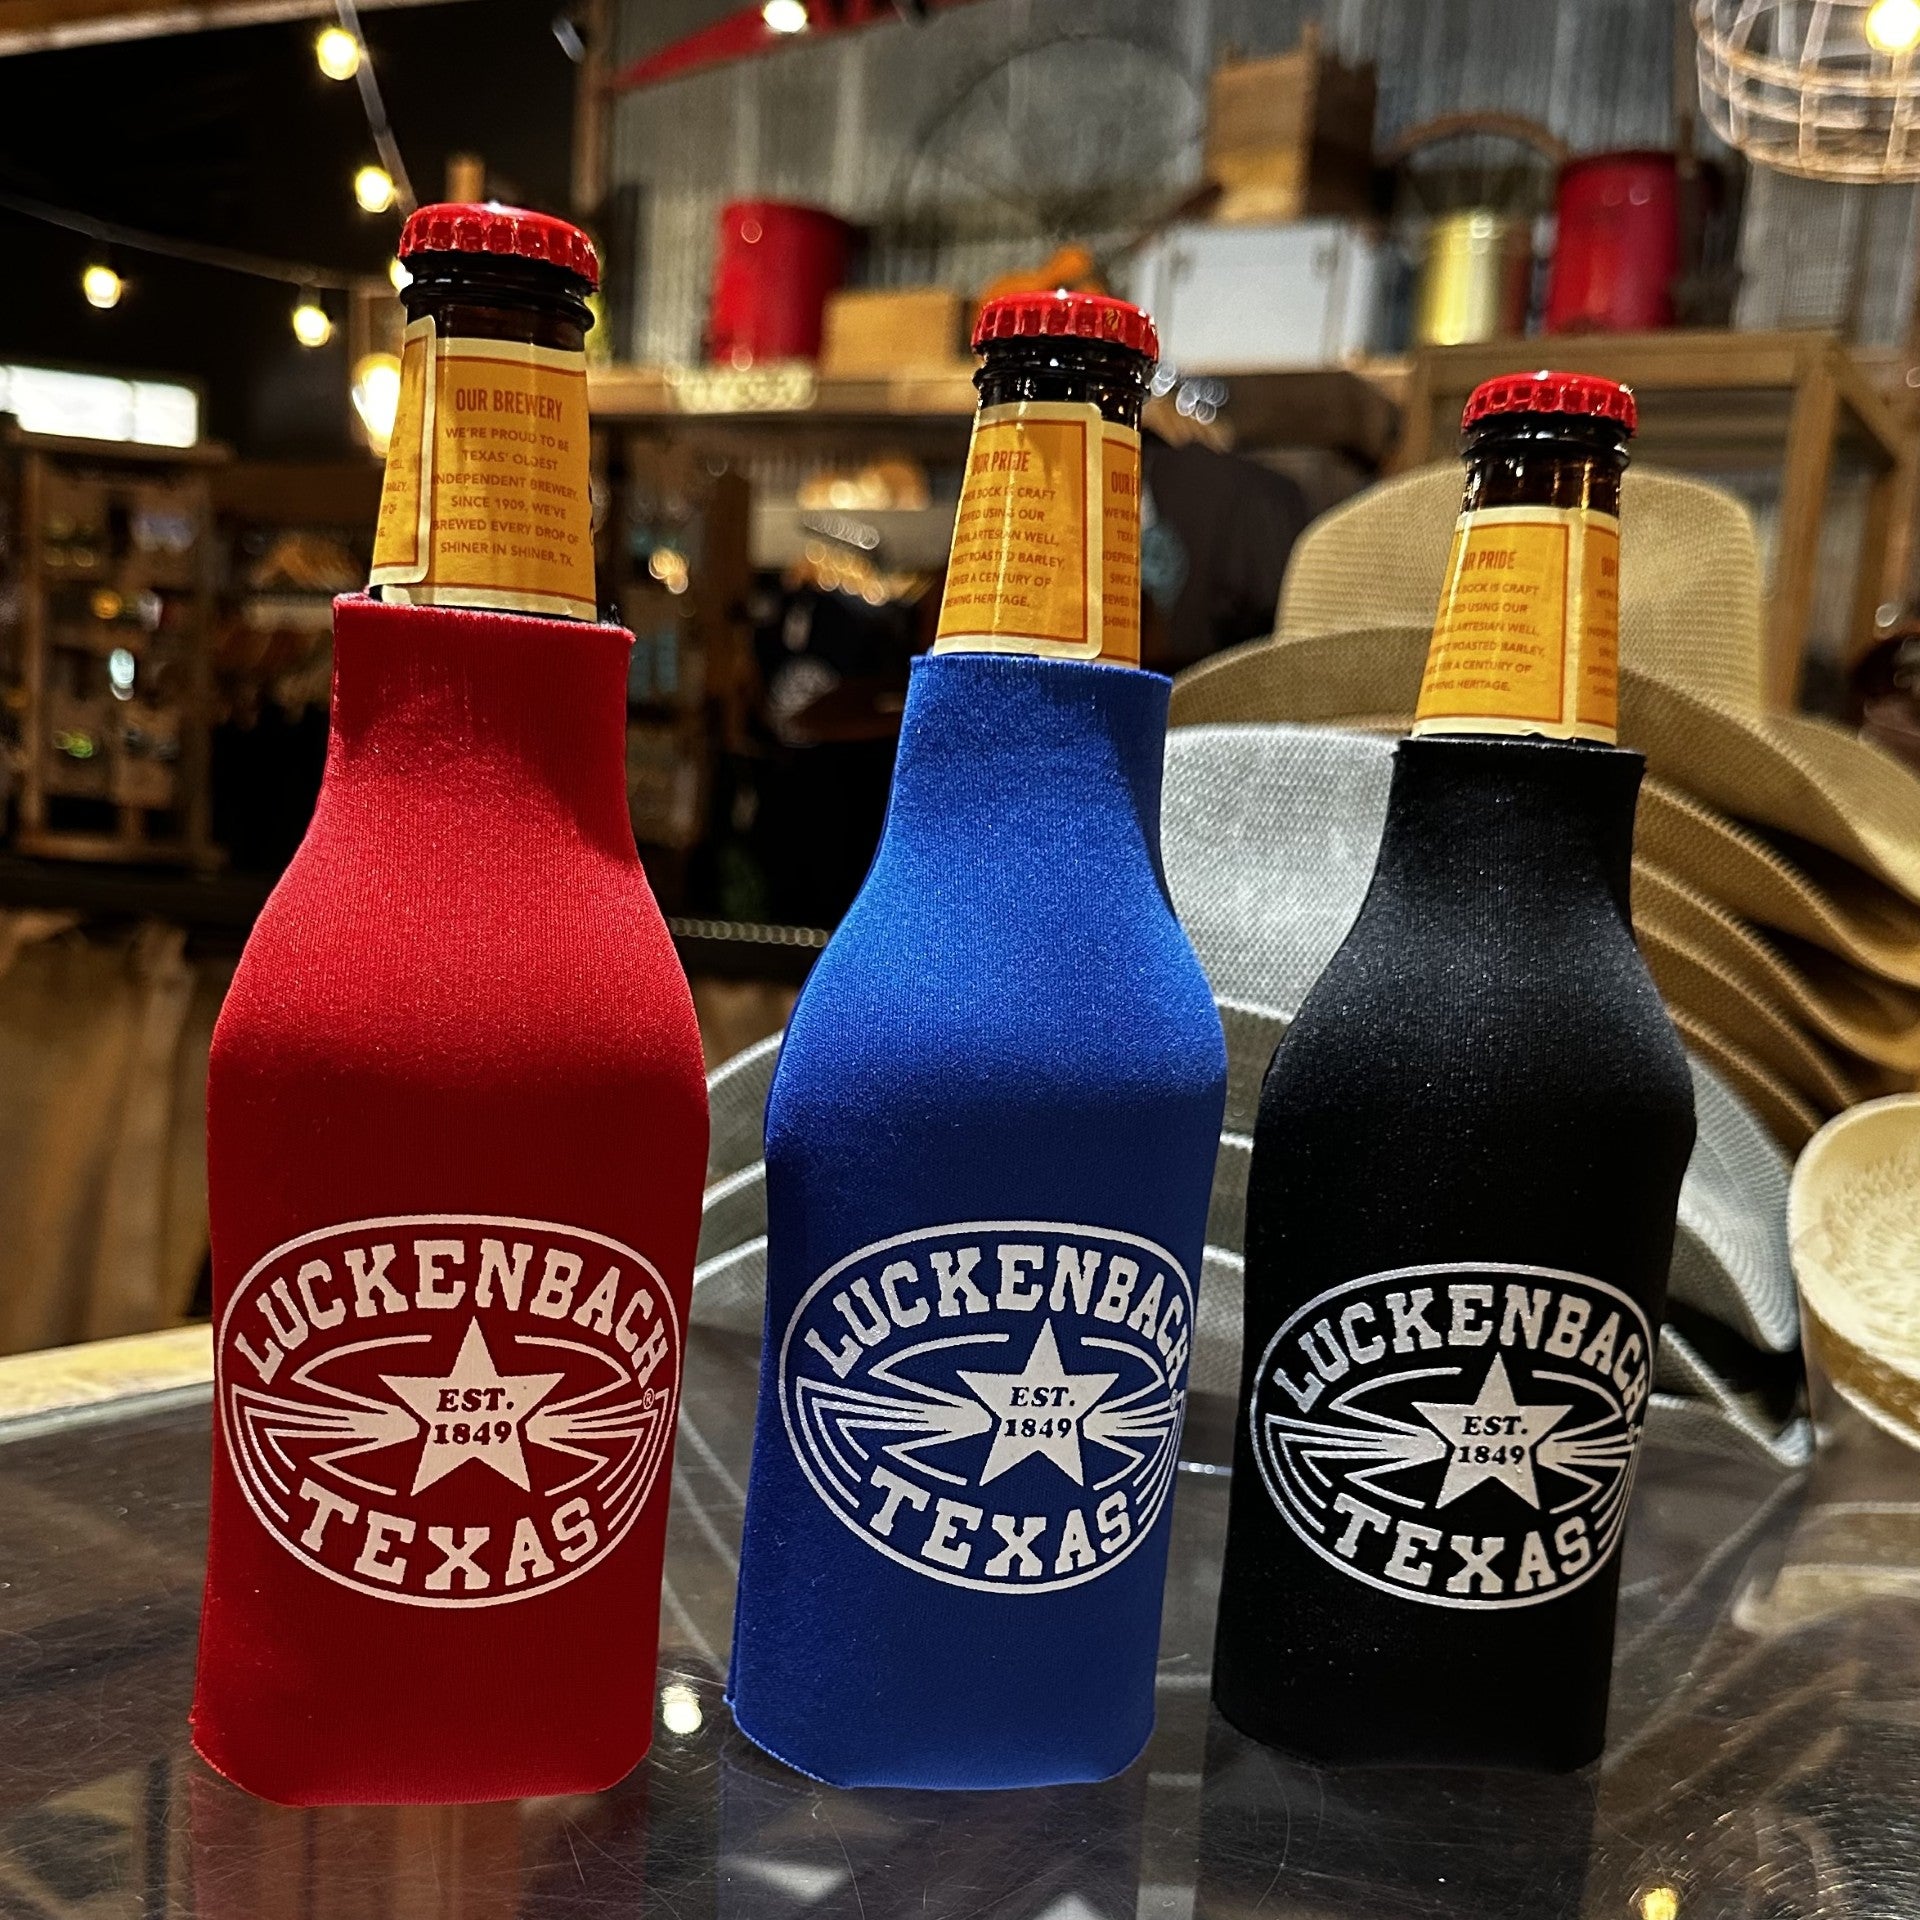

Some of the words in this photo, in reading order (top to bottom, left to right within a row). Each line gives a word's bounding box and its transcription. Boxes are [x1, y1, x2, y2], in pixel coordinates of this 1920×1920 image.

[455, 388, 488, 412] OUR
[493, 389, 563, 422] BREWERY
[446, 427, 487, 439] WE'RE
[491, 428, 537, 444] PROUD
[540, 434, 556, 448] TO
[462, 449, 509, 463] TEXAS'
[512, 453, 559, 470] OLDEST
[1111, 471, 1130, 494] OUR
[1017, 487, 1056, 501] CRAFT
[451, 496, 490, 509] SINCE
[495, 499, 529, 513] 1909,
[532, 502, 566, 519] WE'VE
[1018, 509, 1046, 522] OUR
[432, 518, 487, 531] BREWED
[491, 520, 532, 535] EVERY
[535, 525, 566, 541] DROP
[1024, 530, 1060, 547] WELL,
[440, 542, 489, 554] SHINER
[492, 544, 507, 555] IN
[510, 545, 558, 564] SHINER,
[1018, 552, 1065, 569] BARLEY,
[1477, 550, 1517, 570] PRIDE
[1033, 576, 1051, 588] OF
[1502, 583, 1540, 597] CRAFT
[1468, 602, 1499, 613] USING
[1502, 602, 1529, 614] OUR
[1507, 622, 1541, 638] WELL,
[1501, 641, 1545, 658] BARLEY,
[1462, 660, 1513, 671] CENTURY
[1515, 663, 1533, 674] OF
[235, 1239, 669, 1388] LUCKENBACH
[804, 1245, 1189, 1388] LUCKENBACH
[1273, 1284, 1649, 1423] LUCKENBACH
[437, 1388, 514, 1413] EST.
[1009, 1386, 1076, 1407] EST.
[432, 1421, 512, 1446] 1849
[1004, 1418, 1072, 1438] 1849
[1462, 1416, 1528, 1435] EST.
[1458, 1445, 1525, 1466] 1849
[869, 1465, 1131, 1577] TEXAS
[299, 1478, 598, 1591] TEXAS
[1334, 1493, 1591, 1593] TEXAS
